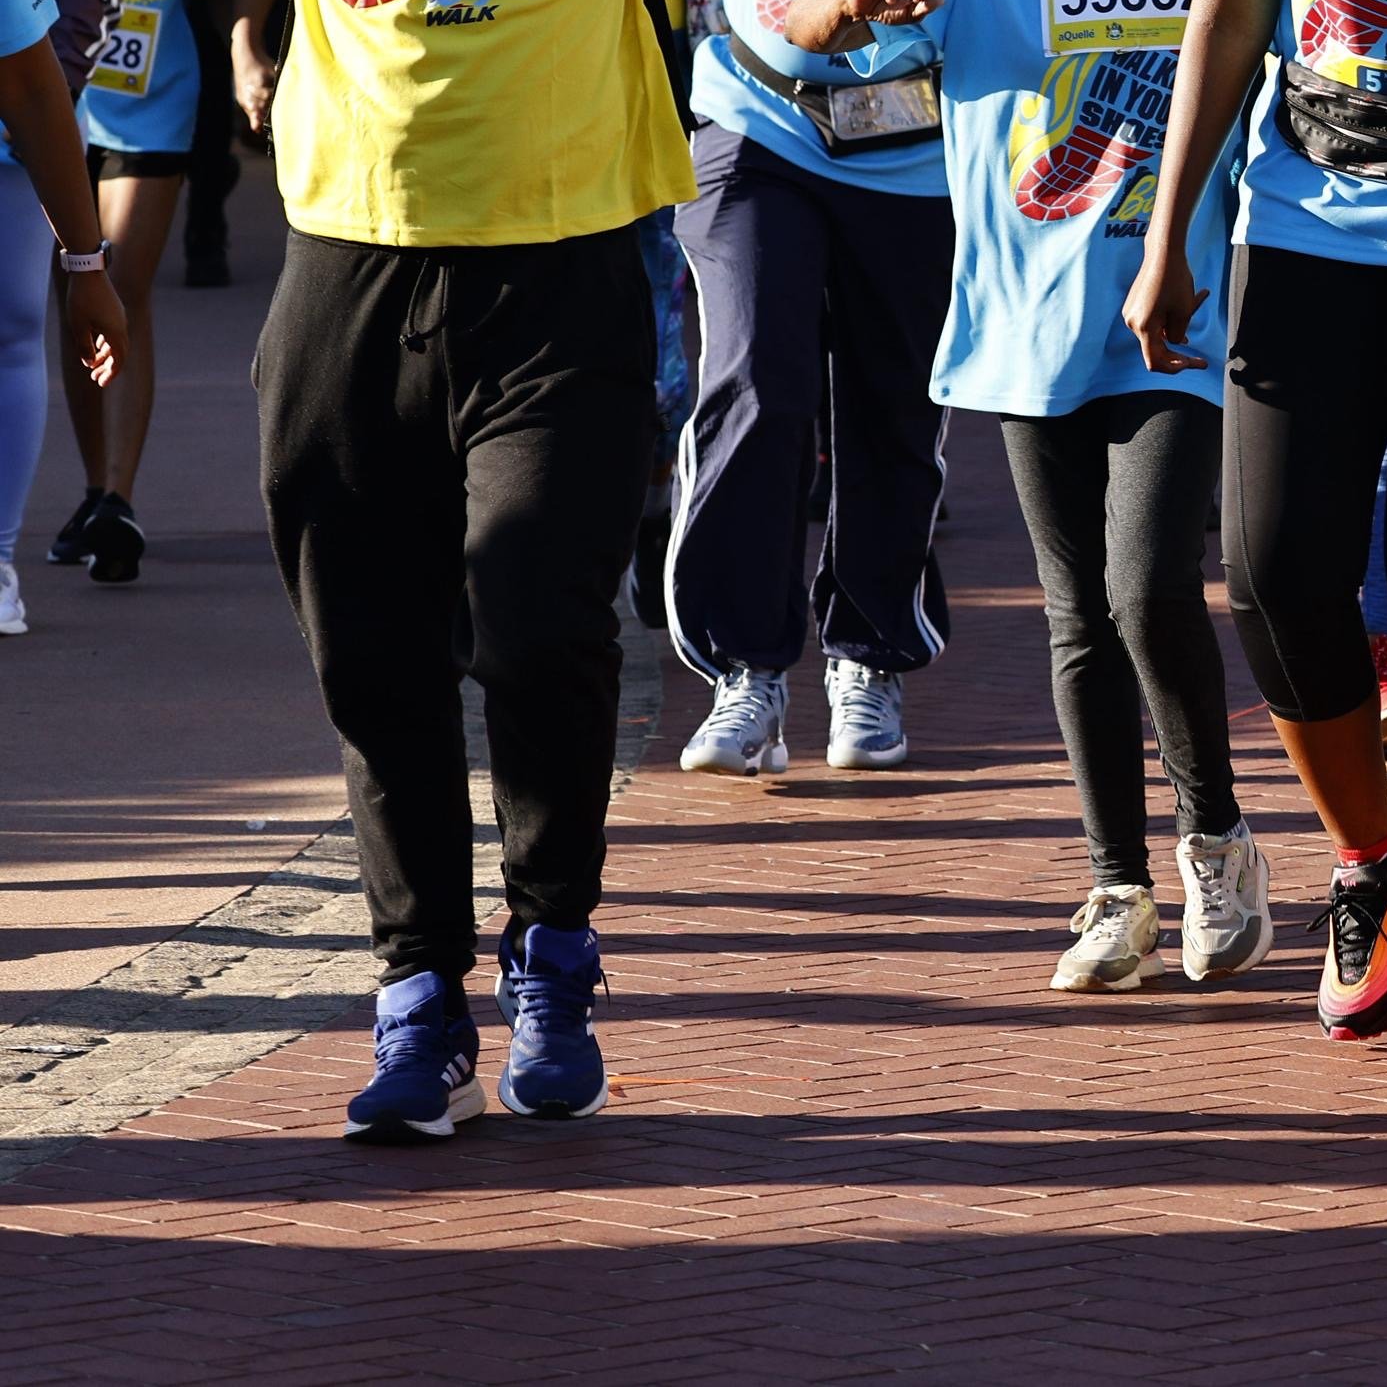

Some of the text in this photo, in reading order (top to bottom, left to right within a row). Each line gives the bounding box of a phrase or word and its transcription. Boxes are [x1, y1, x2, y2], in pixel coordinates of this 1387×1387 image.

[426, 5, 499, 27] WALK
[1366, 70, 1382, 92] 5
[1089, 65, 1171, 126] IN YOU
[1104, 222, 1148, 238] WAL
